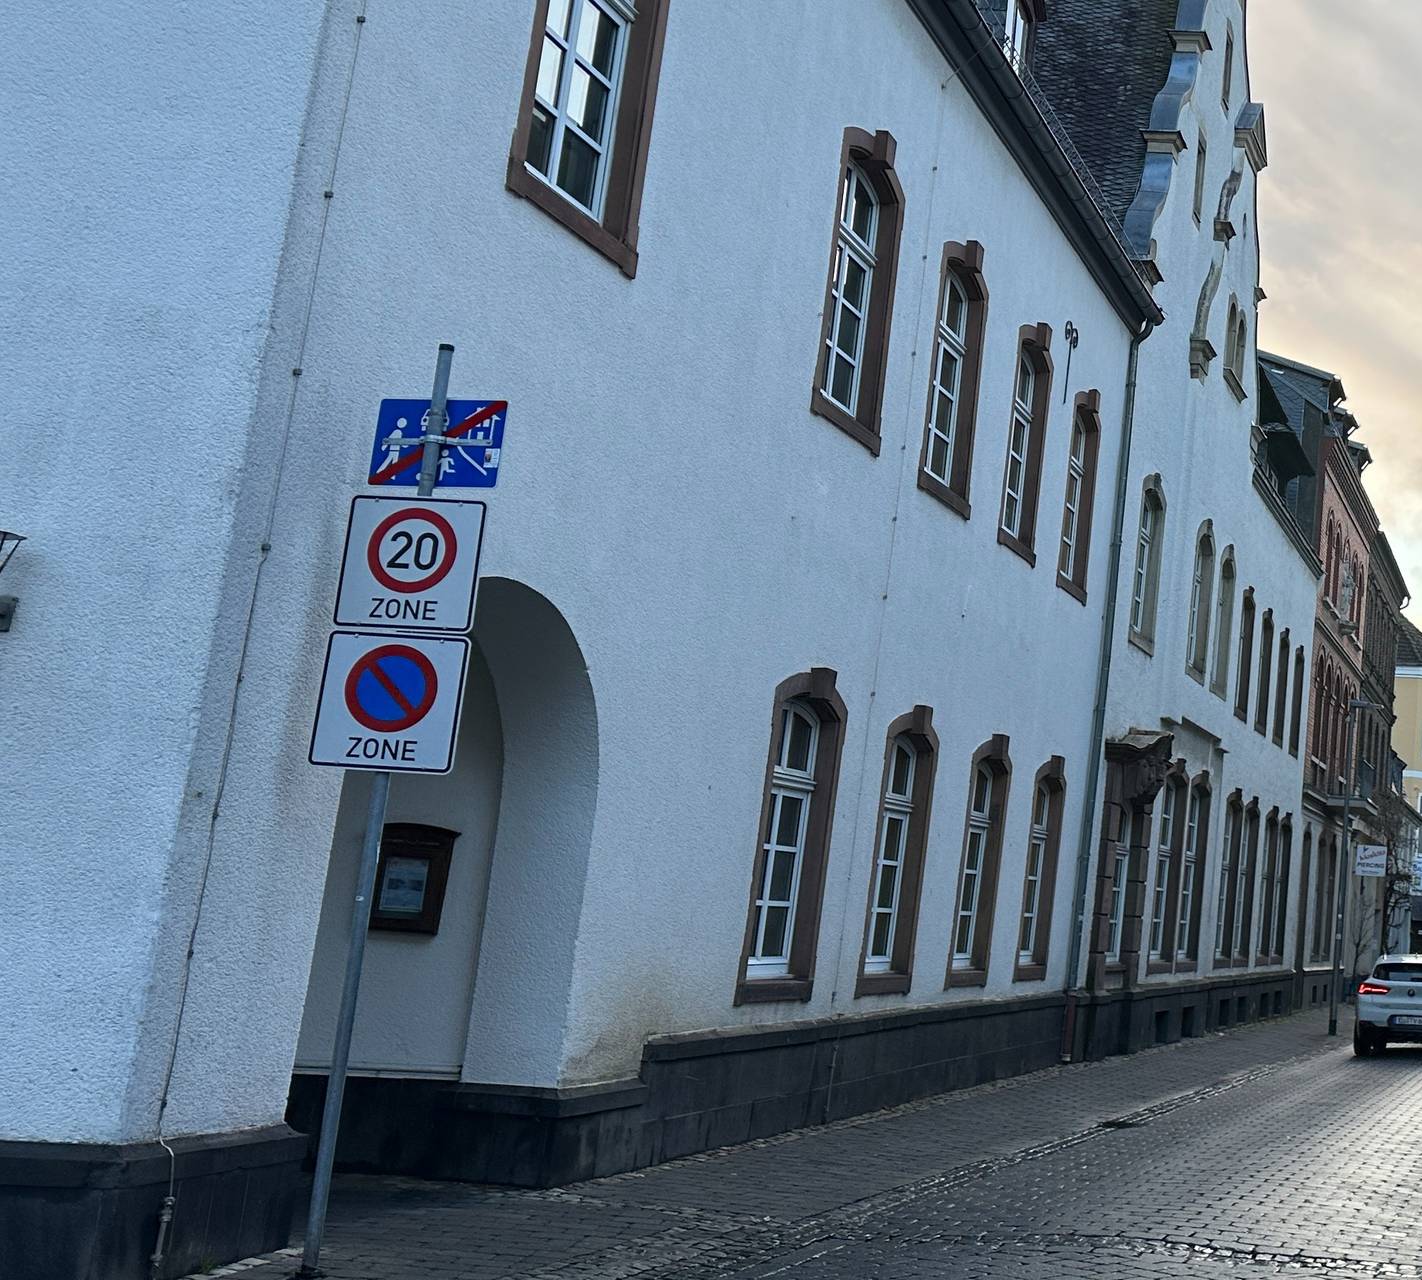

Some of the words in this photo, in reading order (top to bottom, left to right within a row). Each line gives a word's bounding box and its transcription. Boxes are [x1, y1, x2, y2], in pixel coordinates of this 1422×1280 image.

[386, 530, 439, 571] 20
[369, 598, 438, 622] ZONE
[345, 737, 418, 762] ZONE
